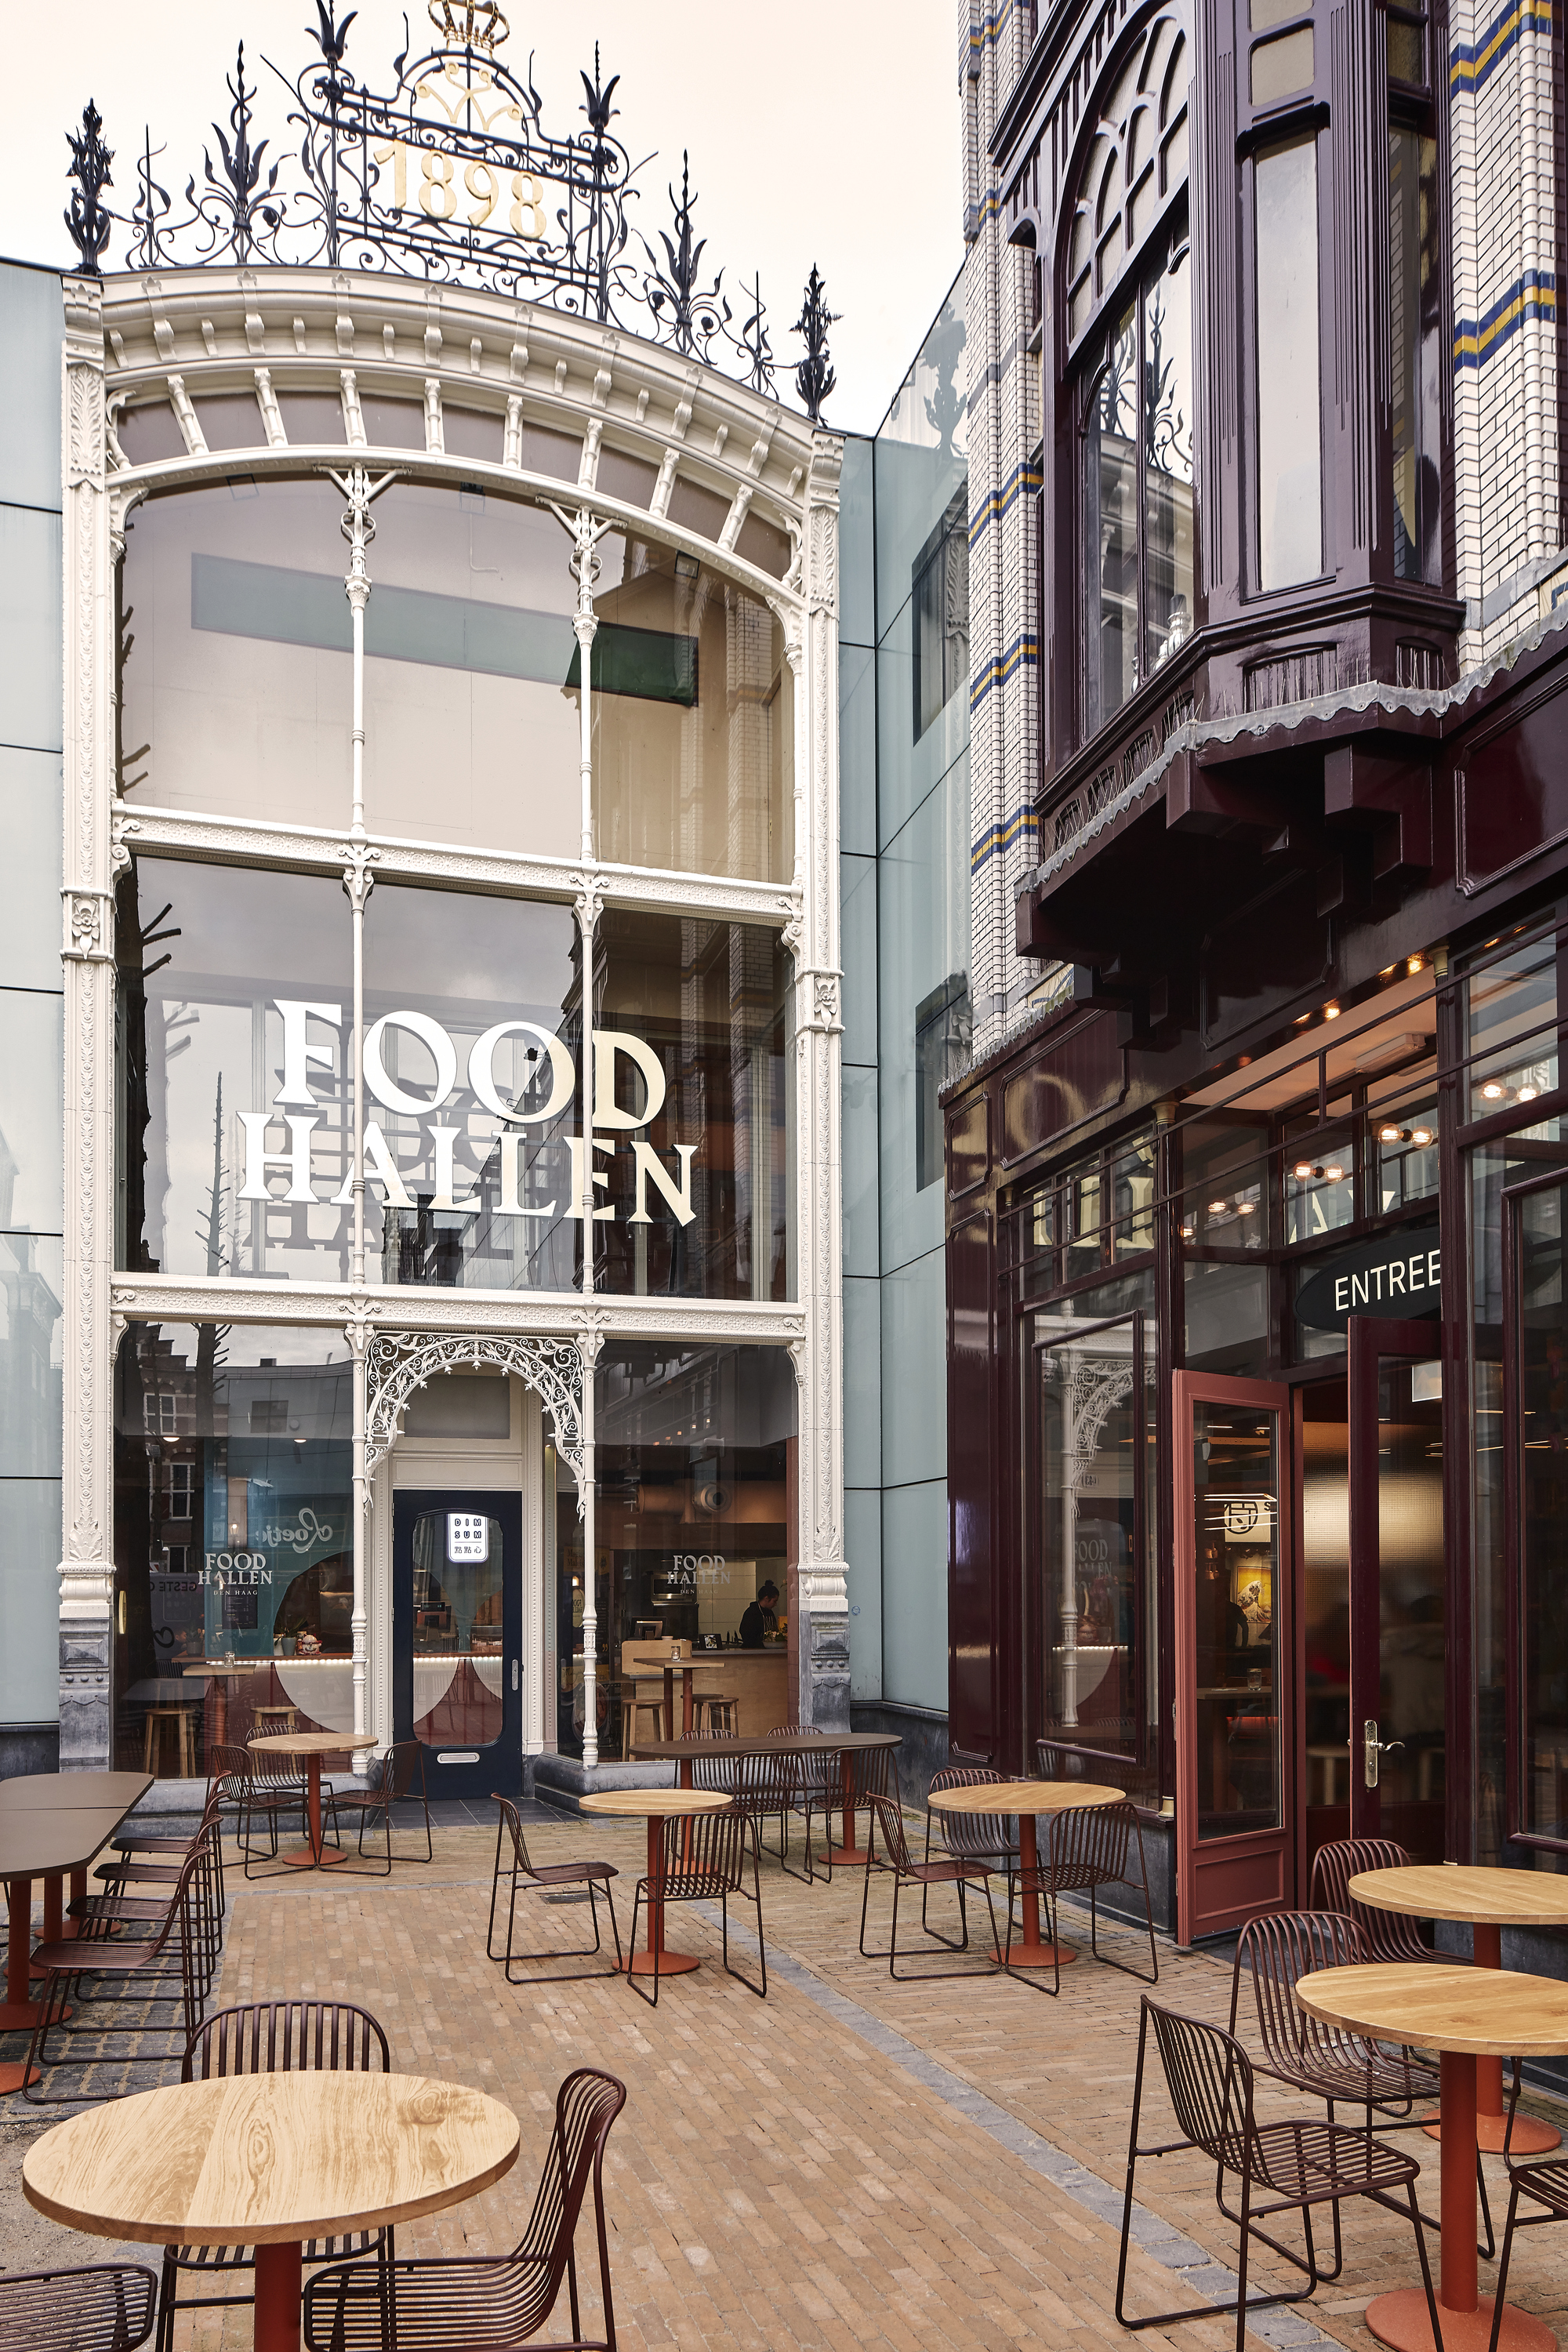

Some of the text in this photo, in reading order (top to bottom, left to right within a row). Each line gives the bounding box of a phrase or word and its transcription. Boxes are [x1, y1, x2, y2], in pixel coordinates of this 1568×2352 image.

[373, 139, 547, 239] 1898
[272, 998, 666, 1130] FOOD
[235, 1110, 698, 1228] HALLEN
[1334, 1249, 1441, 1312] ENTREE
[455, 1518, 481, 1526] DIM
[455, 1530, 481, 1539] SUM
[205, 1552, 267, 1570] FOOD
[673, 1555, 726, 1571] FOOD
[198, 1570, 273, 1584] HALLEN
[666, 1571, 731, 1584] HALLEN
